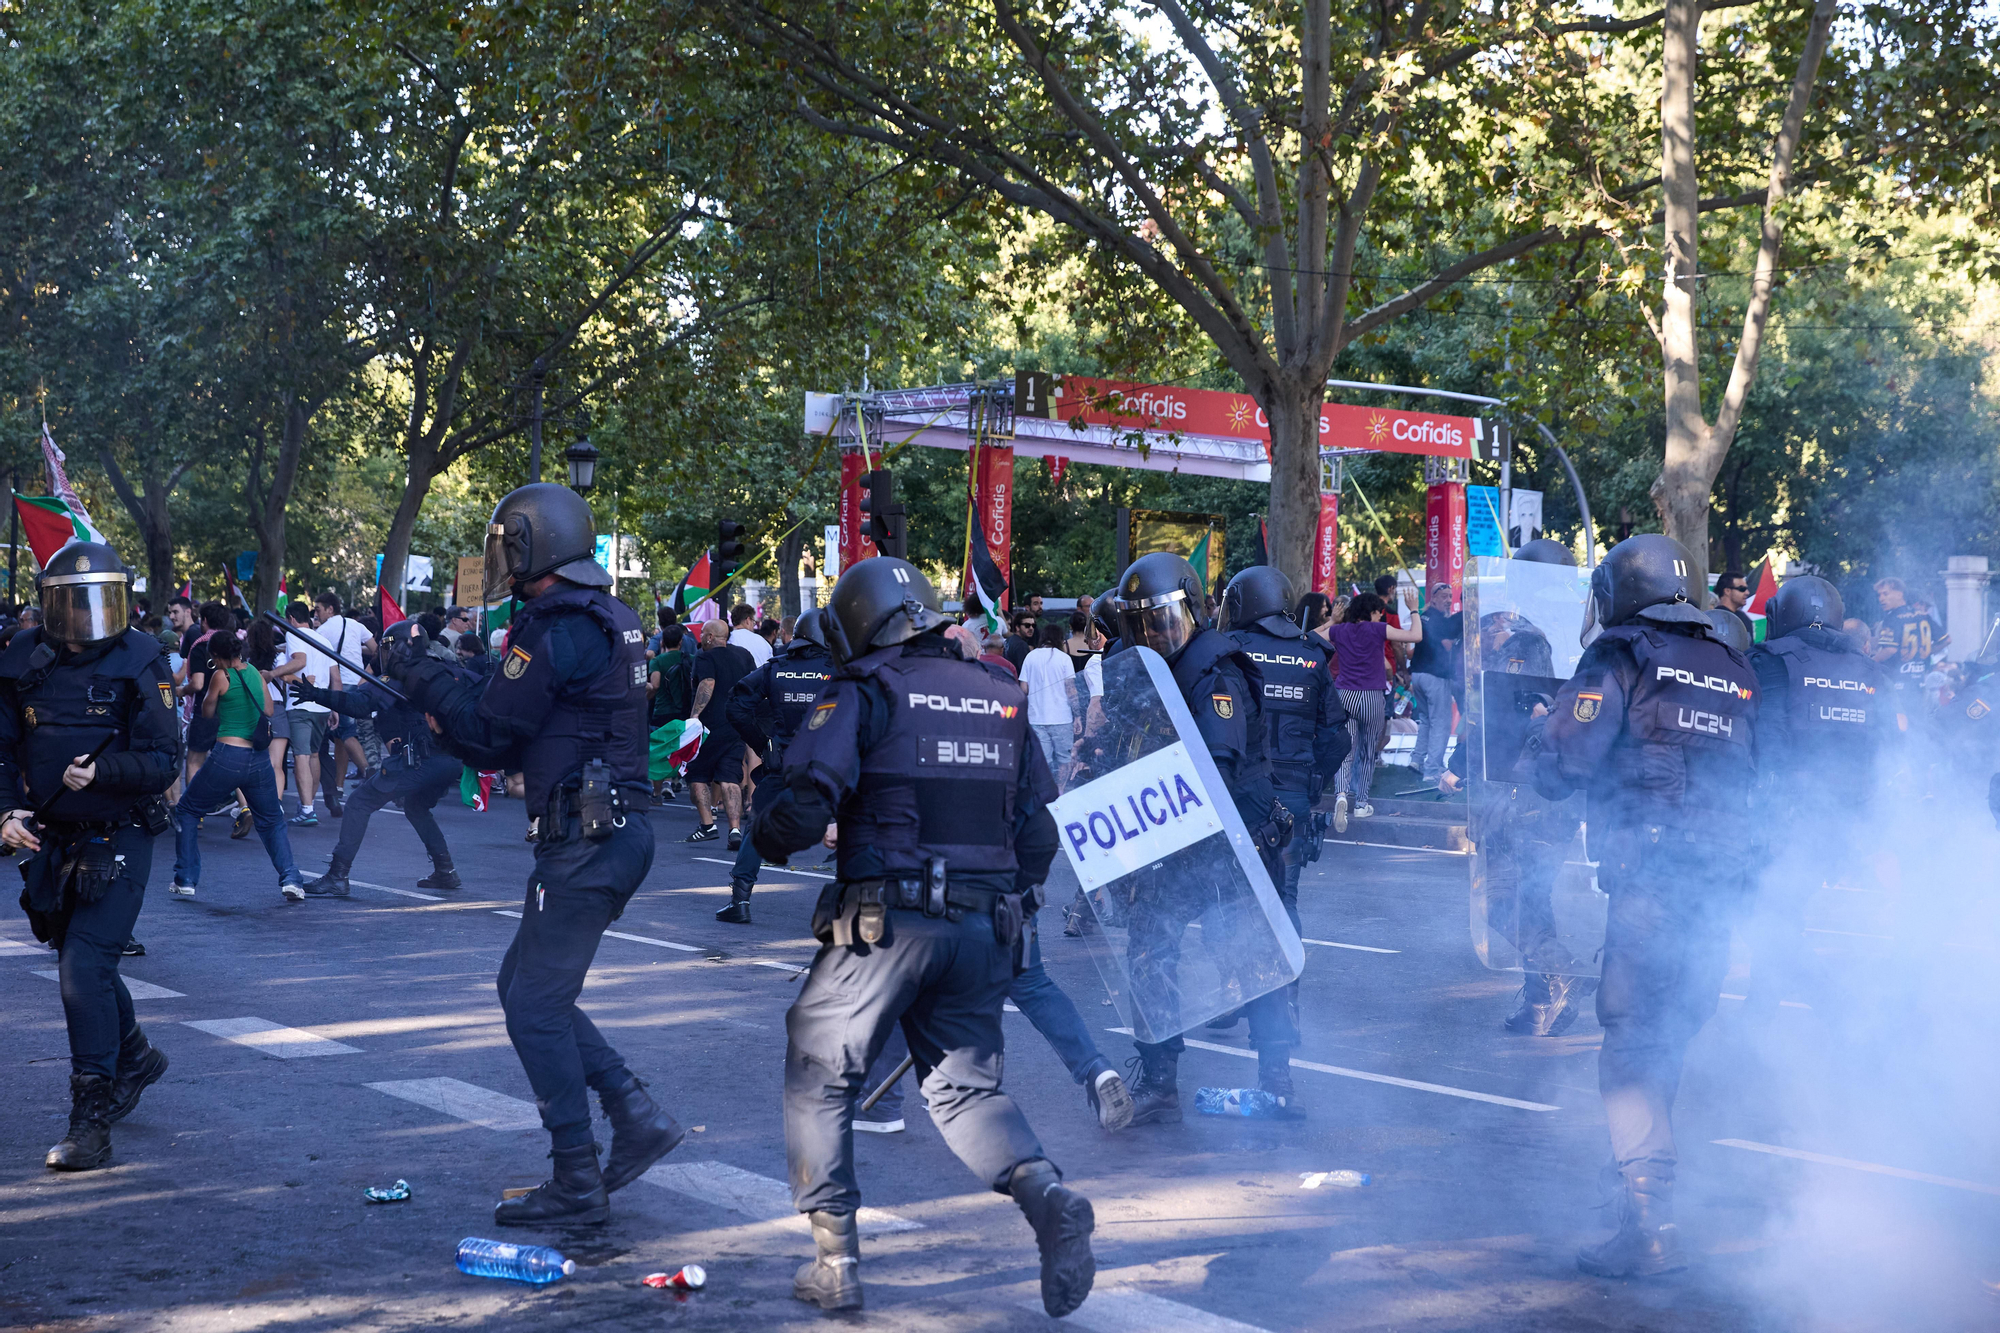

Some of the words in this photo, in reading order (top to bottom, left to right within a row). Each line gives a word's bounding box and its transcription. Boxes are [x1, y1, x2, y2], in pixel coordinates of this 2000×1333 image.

[1027, 376, 1035, 400] 1
[1109, 389, 1187, 419] Cofidis
[1392, 418, 1463, 446] Cofidis
[1492, 425, 1500, 447] 1
[841, 489, 849, 546] Cofidis
[992, 484, 1006, 545] Cofidis
[1322, 526, 1332, 577] Cofidis
[1429, 515, 1440, 570] Cofidis
[1452, 515, 1462, 570] Cofidis
[1656, 666, 1741, 696] POLICIA
[1804, 677, 1868, 692] POLICIA
[909, 693, 1005, 715] POLICIA
[1820, 706, 1866, 723] UC223
[1678, 708, 1732, 737] UC24
[1064, 773, 1203, 862] POLICIA
